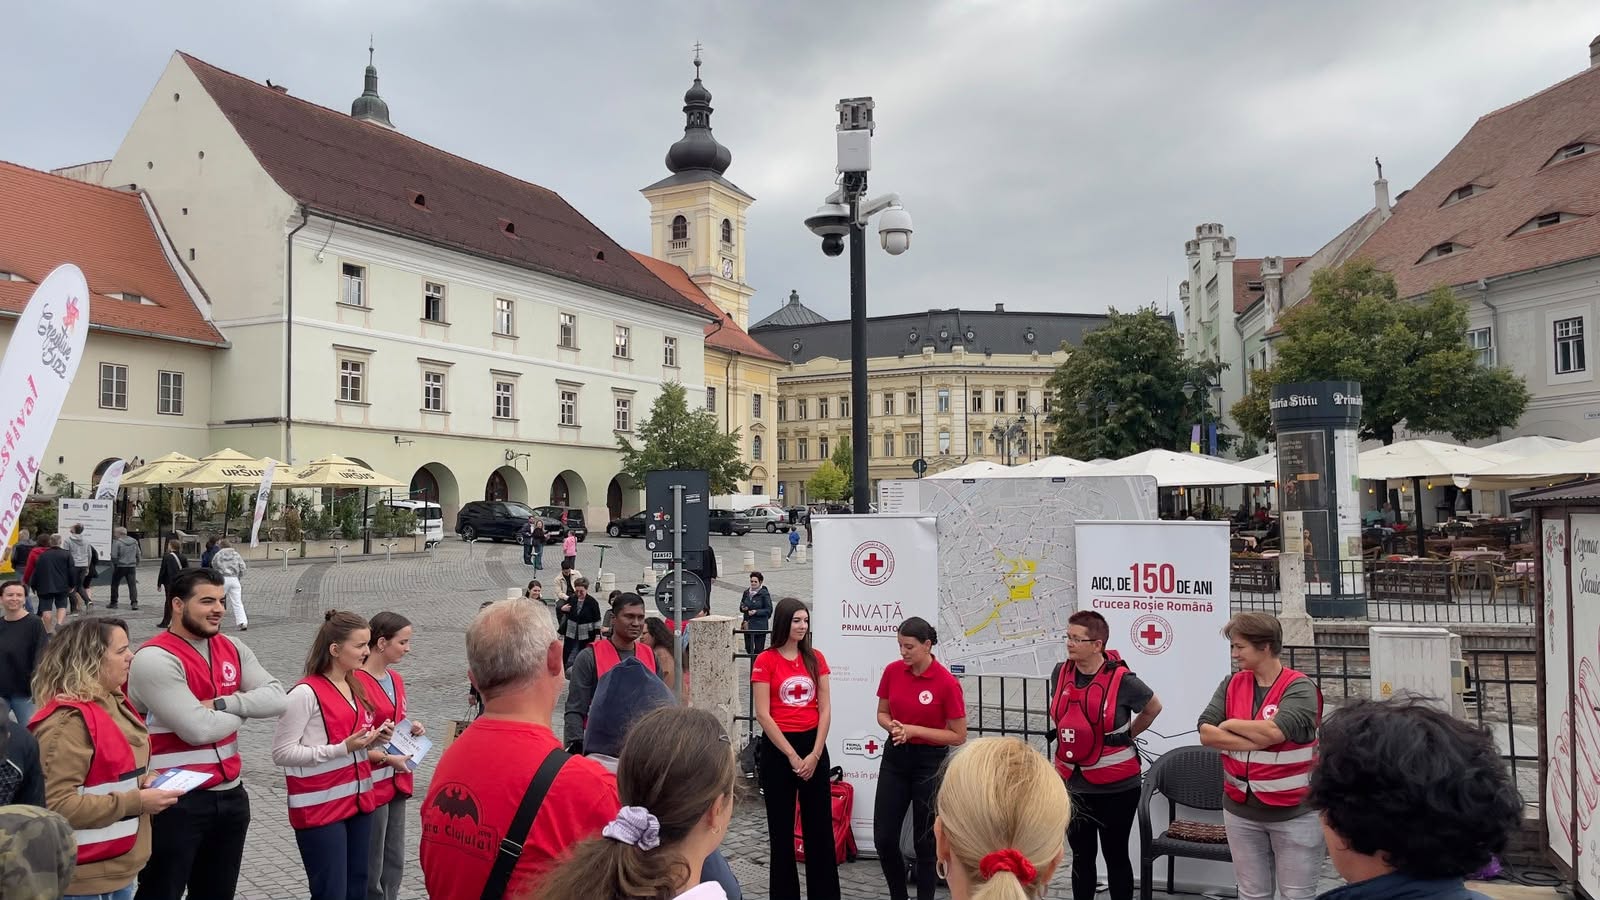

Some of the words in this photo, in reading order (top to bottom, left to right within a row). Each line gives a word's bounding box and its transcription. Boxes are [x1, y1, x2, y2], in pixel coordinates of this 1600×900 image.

[1288, 394, 1318, 407] Sibiu
[0, 374, 38, 482] stival
[339, 472, 375, 480] URSUS
[1091, 576, 1115, 592] AICI,
[1117, 577, 1131, 591] DE
[1129, 562, 1175, 594] 150
[1176, 580, 1191, 595] DE
[1193, 581, 1213, 595] ANI
[841, 599, 904, 623] ÎNVAȚĂ
[1092, 598, 1130, 610] Crucea
[1133, 599, 1164, 613] Roșie
[1166, 601, 1213, 613] Română
[841, 624, 872, 632] PRIMUL
[874, 624, 898, 633] AJUTO
[843, 771, 859, 779] ansă
